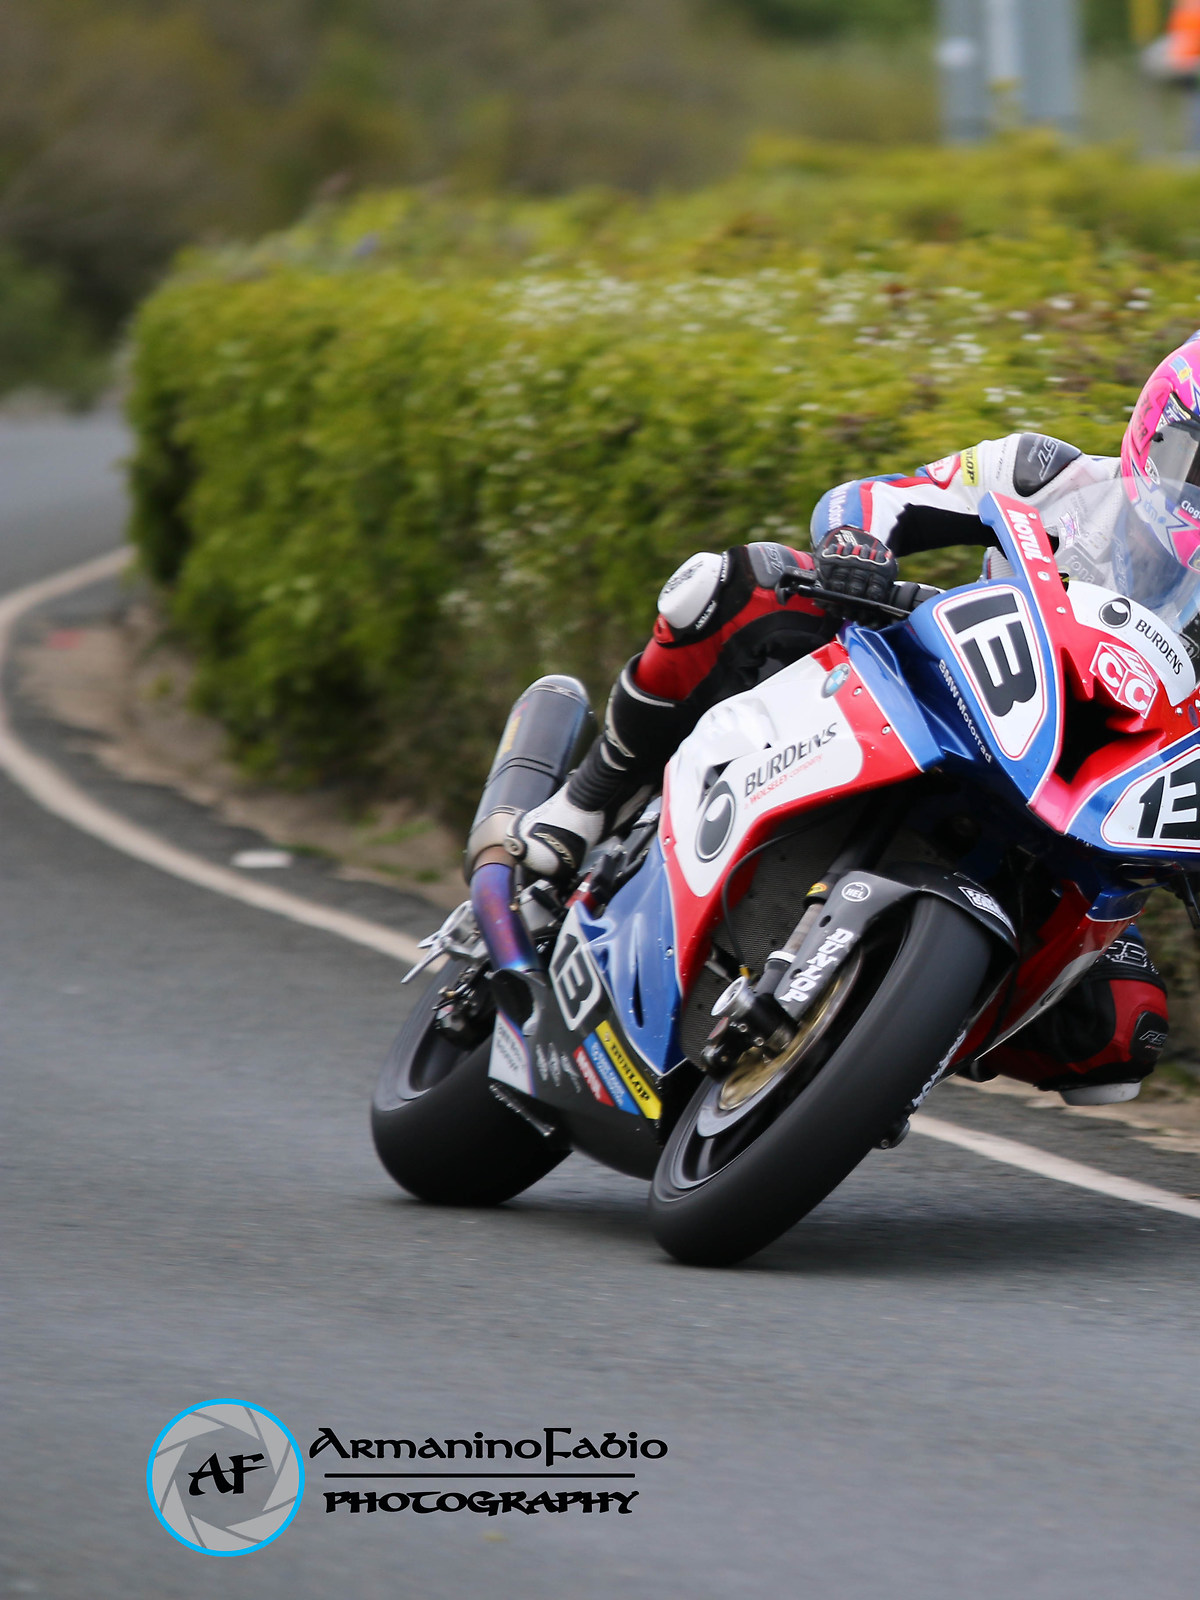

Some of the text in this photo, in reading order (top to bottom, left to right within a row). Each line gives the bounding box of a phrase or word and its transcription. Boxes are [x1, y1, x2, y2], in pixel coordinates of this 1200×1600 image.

[1007, 508, 1043, 562] MOTUL
[943, 592, 1037, 717] 13
[1135, 618, 1184, 675] BURDENS
[938, 658, 992, 763] BMW Motorrad
[744, 721, 838, 798] BURDENS
[550, 932, 594, 1020] 13
[778, 927, 855, 1004] DUNLOP
